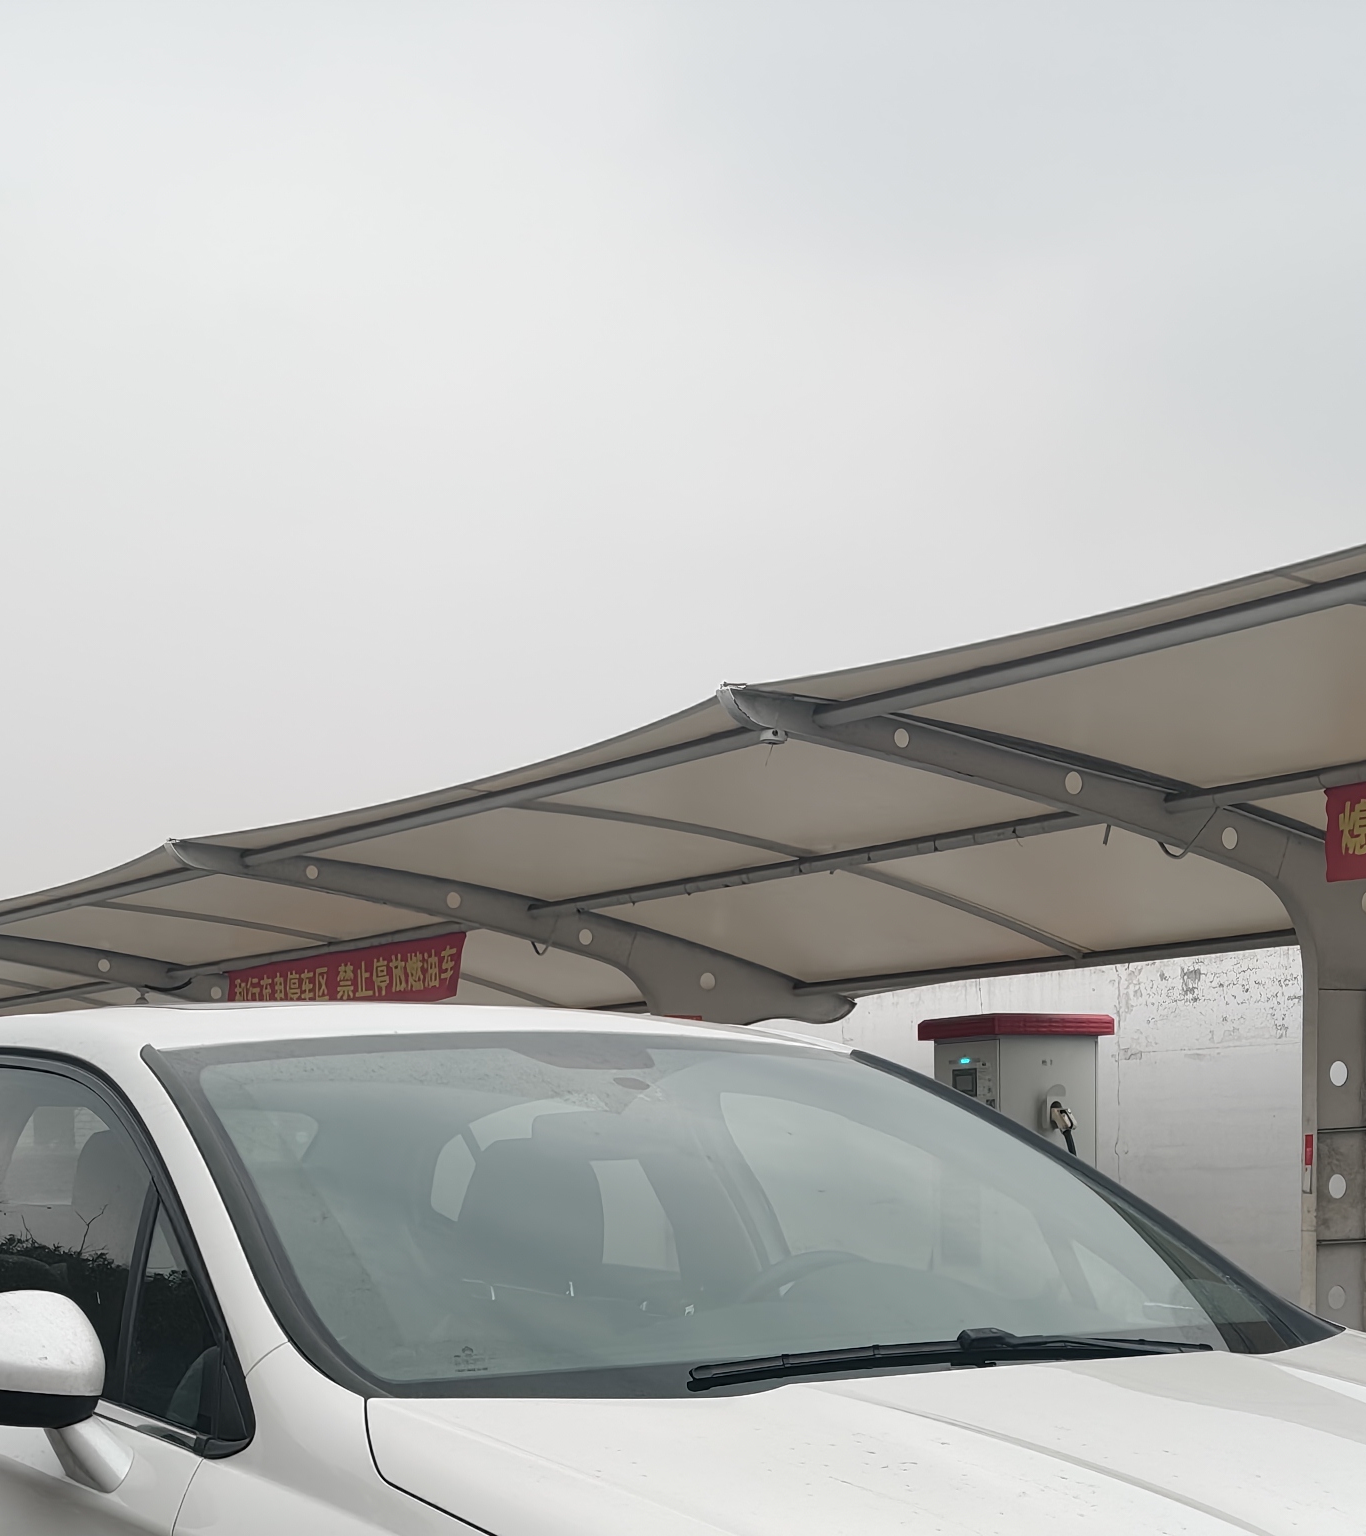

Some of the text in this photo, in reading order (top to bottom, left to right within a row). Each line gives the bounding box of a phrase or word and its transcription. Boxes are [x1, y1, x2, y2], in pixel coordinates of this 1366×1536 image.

[337, 945, 457, 1000] 禁止停放燃油车
